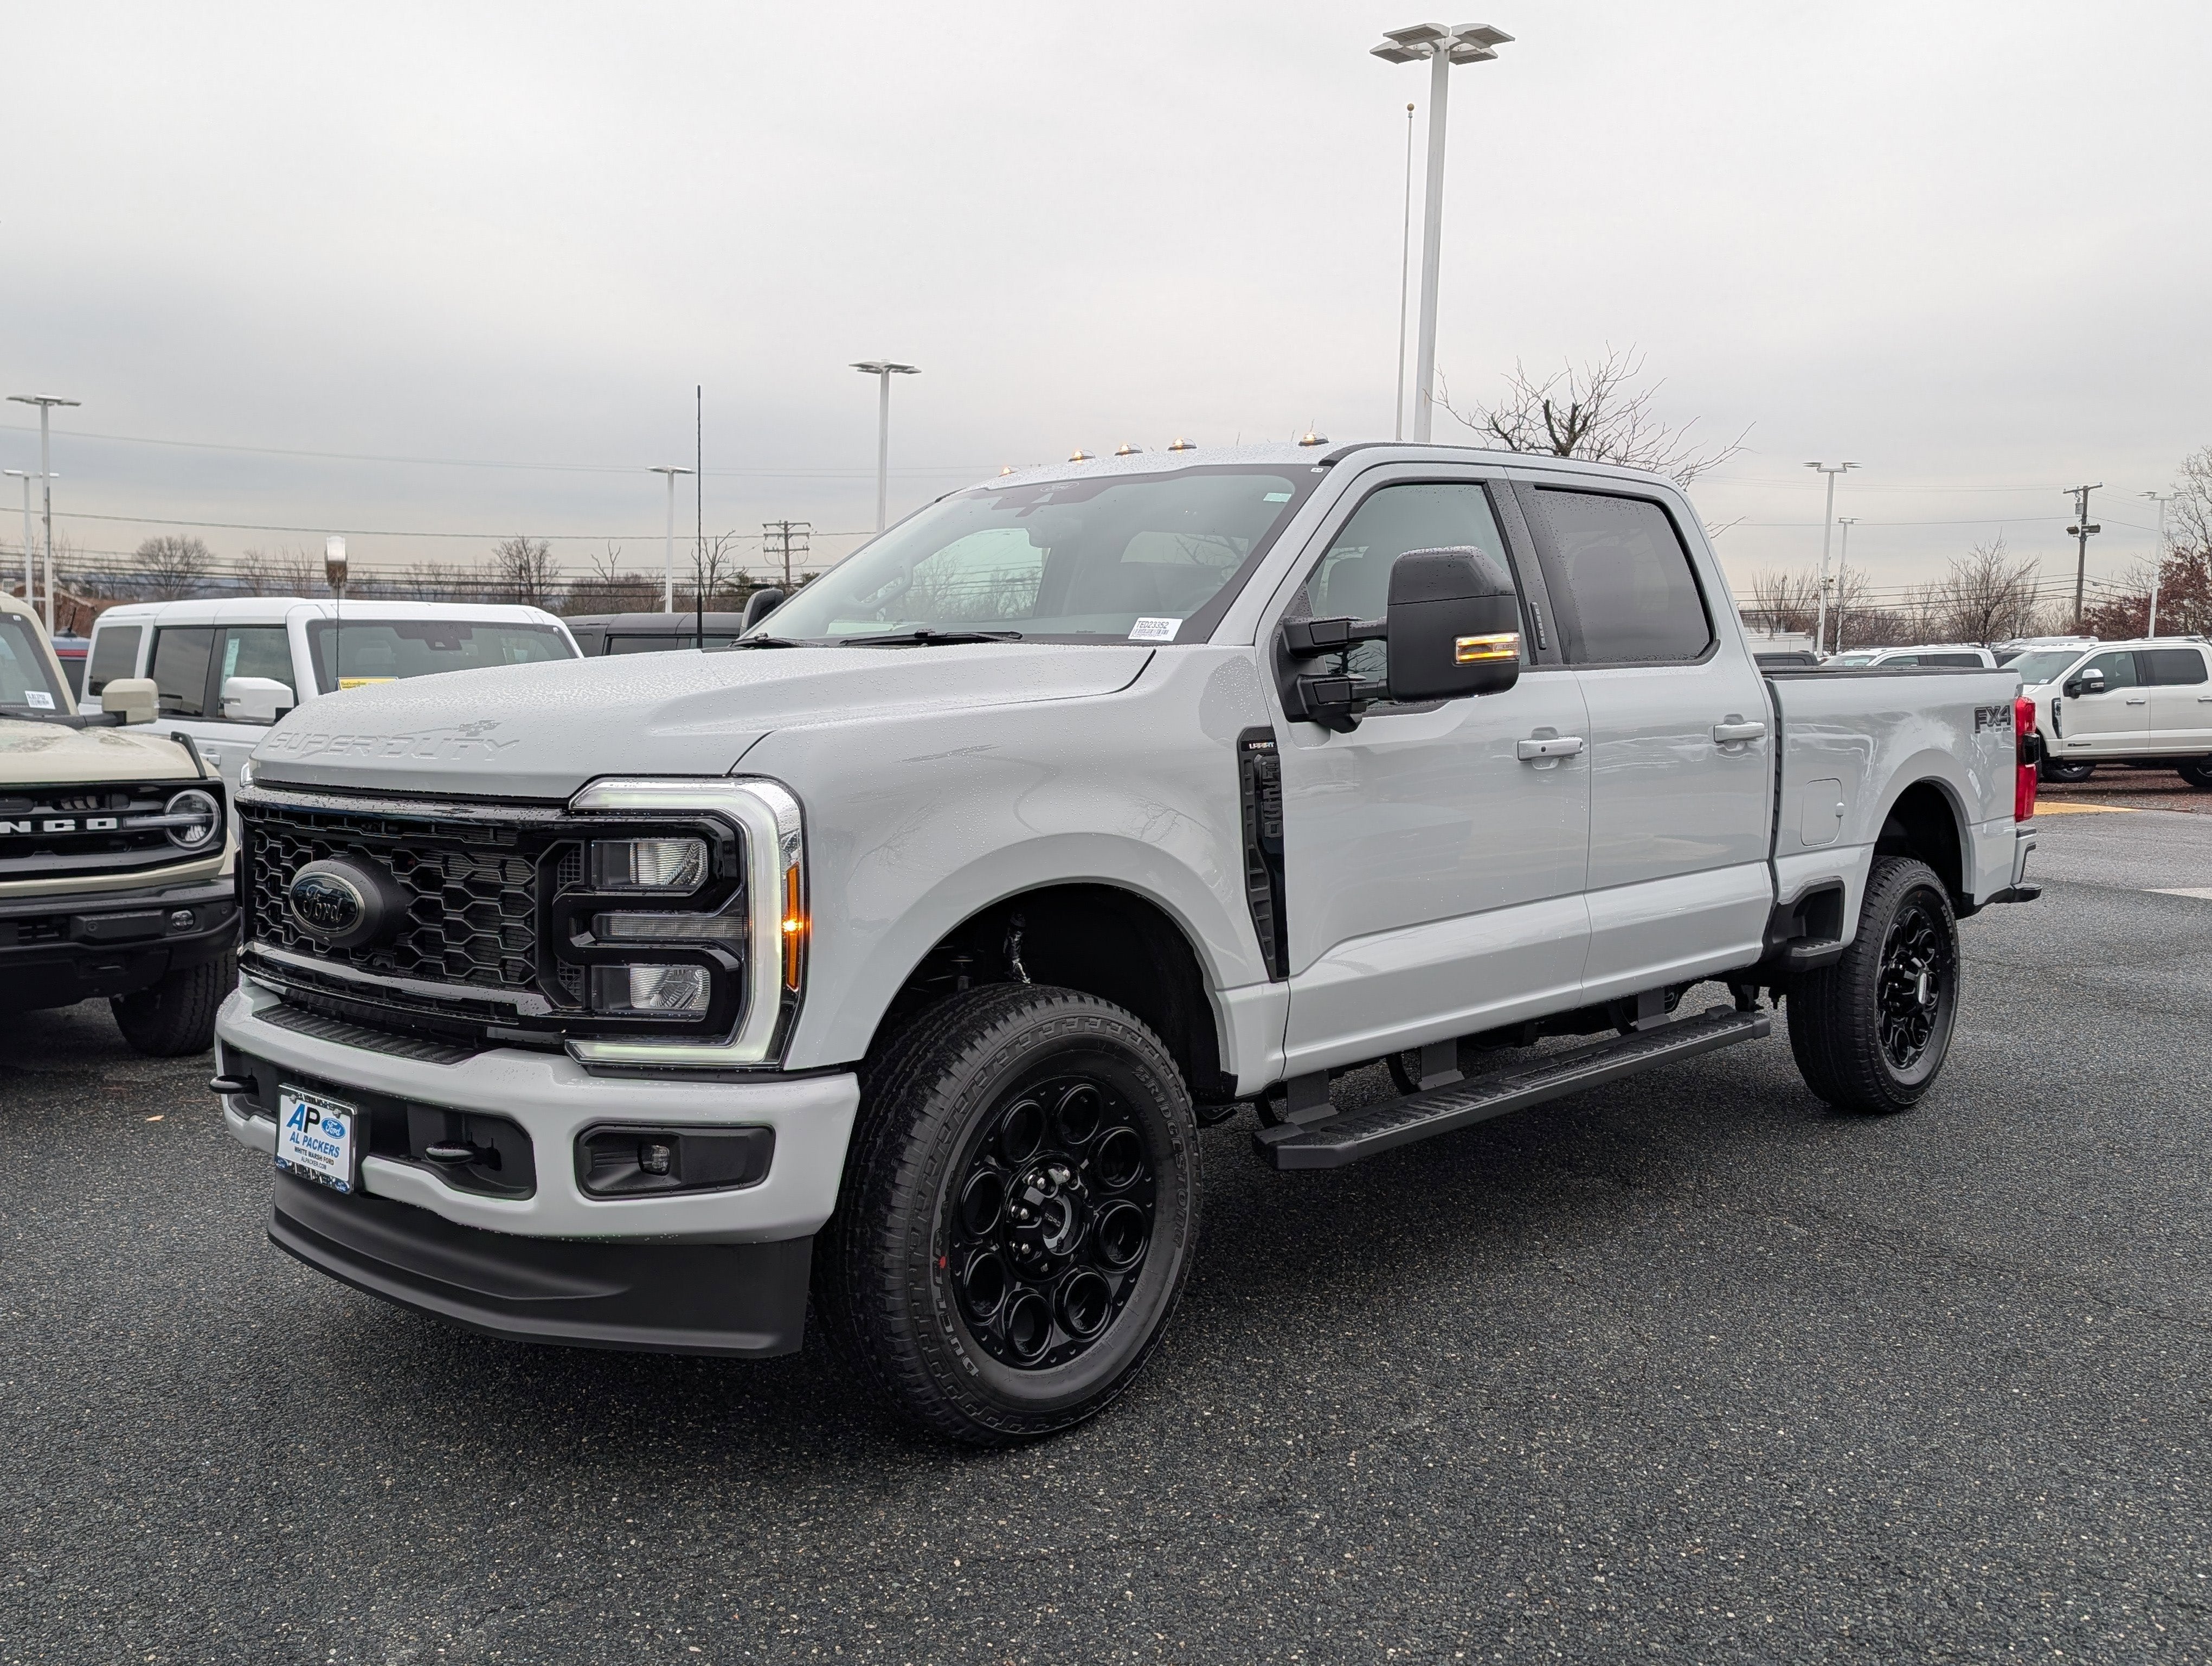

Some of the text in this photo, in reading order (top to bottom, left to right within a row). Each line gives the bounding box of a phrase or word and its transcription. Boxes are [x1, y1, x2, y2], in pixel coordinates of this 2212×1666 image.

[1974, 705, 2011, 734] FX4
[265, 732, 520, 761] SUPER DUTY
[303, 883, 343, 922] Ford
[286, 1103, 320, 1133] AP
[290, 1131, 340, 1158] AL PACKERS
[294, 1146, 335, 1166] WHITE MARSH FORD
